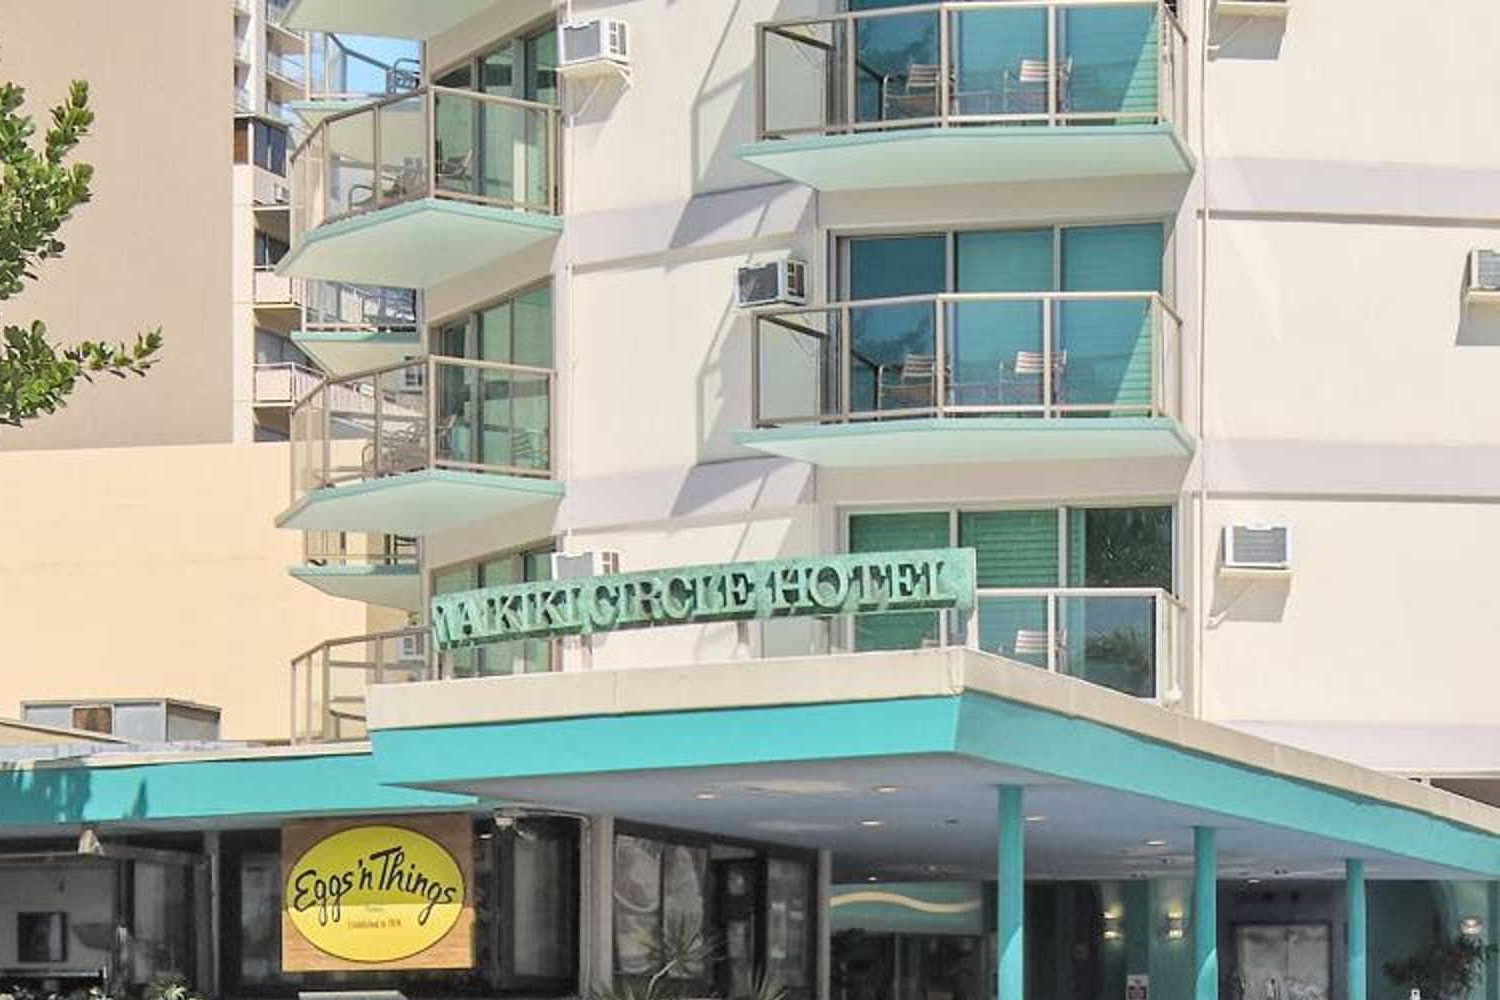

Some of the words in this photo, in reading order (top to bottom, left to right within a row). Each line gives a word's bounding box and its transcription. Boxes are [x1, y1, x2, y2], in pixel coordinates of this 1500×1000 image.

[590, 572, 757, 628] CIRCLE
[768, 560, 957, 611] HOTEL
[293, 869, 353, 925] Eggs
[370, 846, 456, 926] Things
